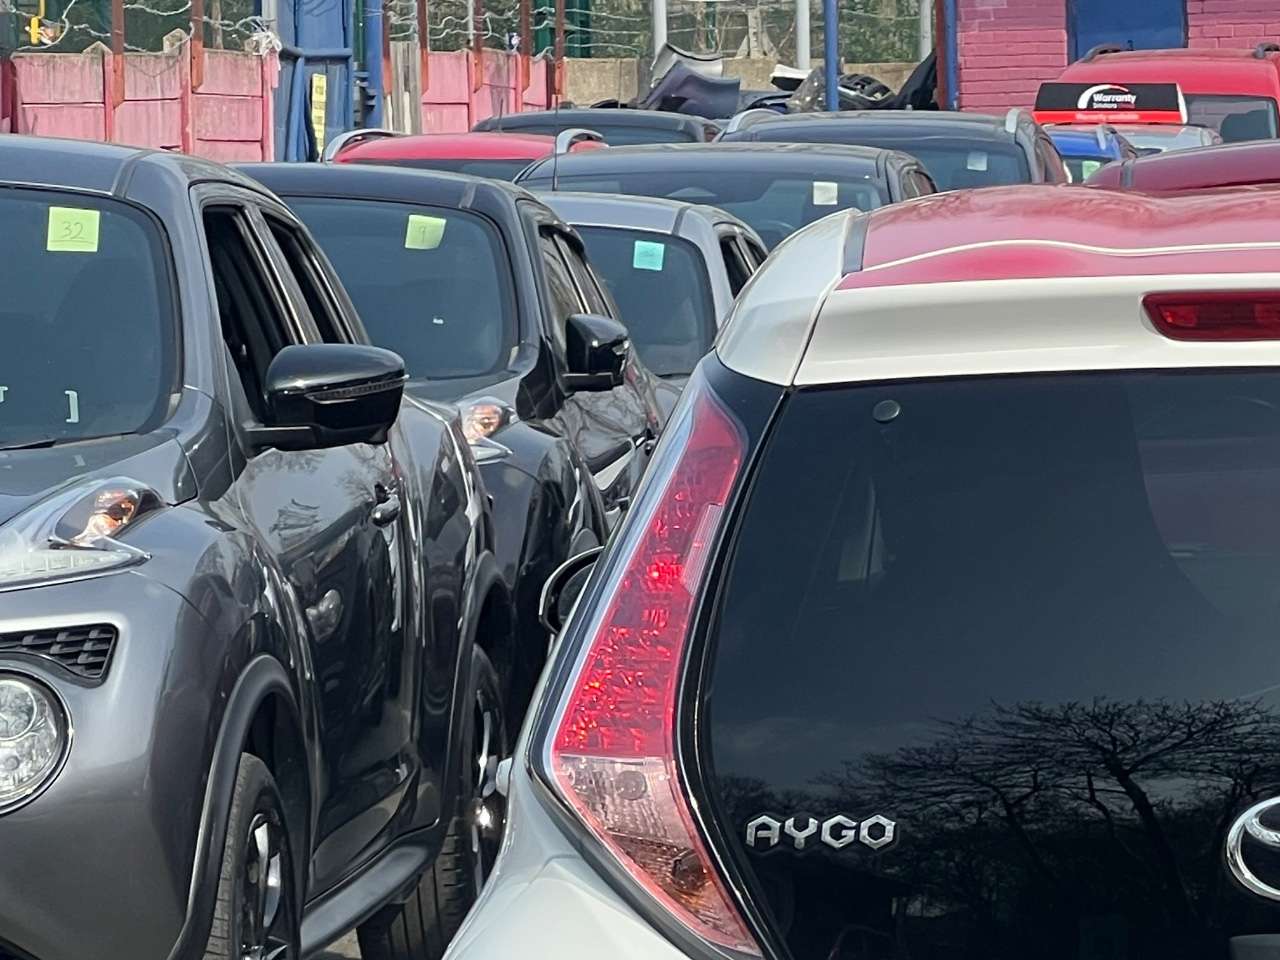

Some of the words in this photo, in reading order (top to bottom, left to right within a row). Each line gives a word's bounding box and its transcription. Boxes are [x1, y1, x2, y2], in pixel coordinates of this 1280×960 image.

[1092, 93, 1137, 104] Warranty
[62, 219, 85, 240] 32
[745, 814, 897, 850] AYGO
